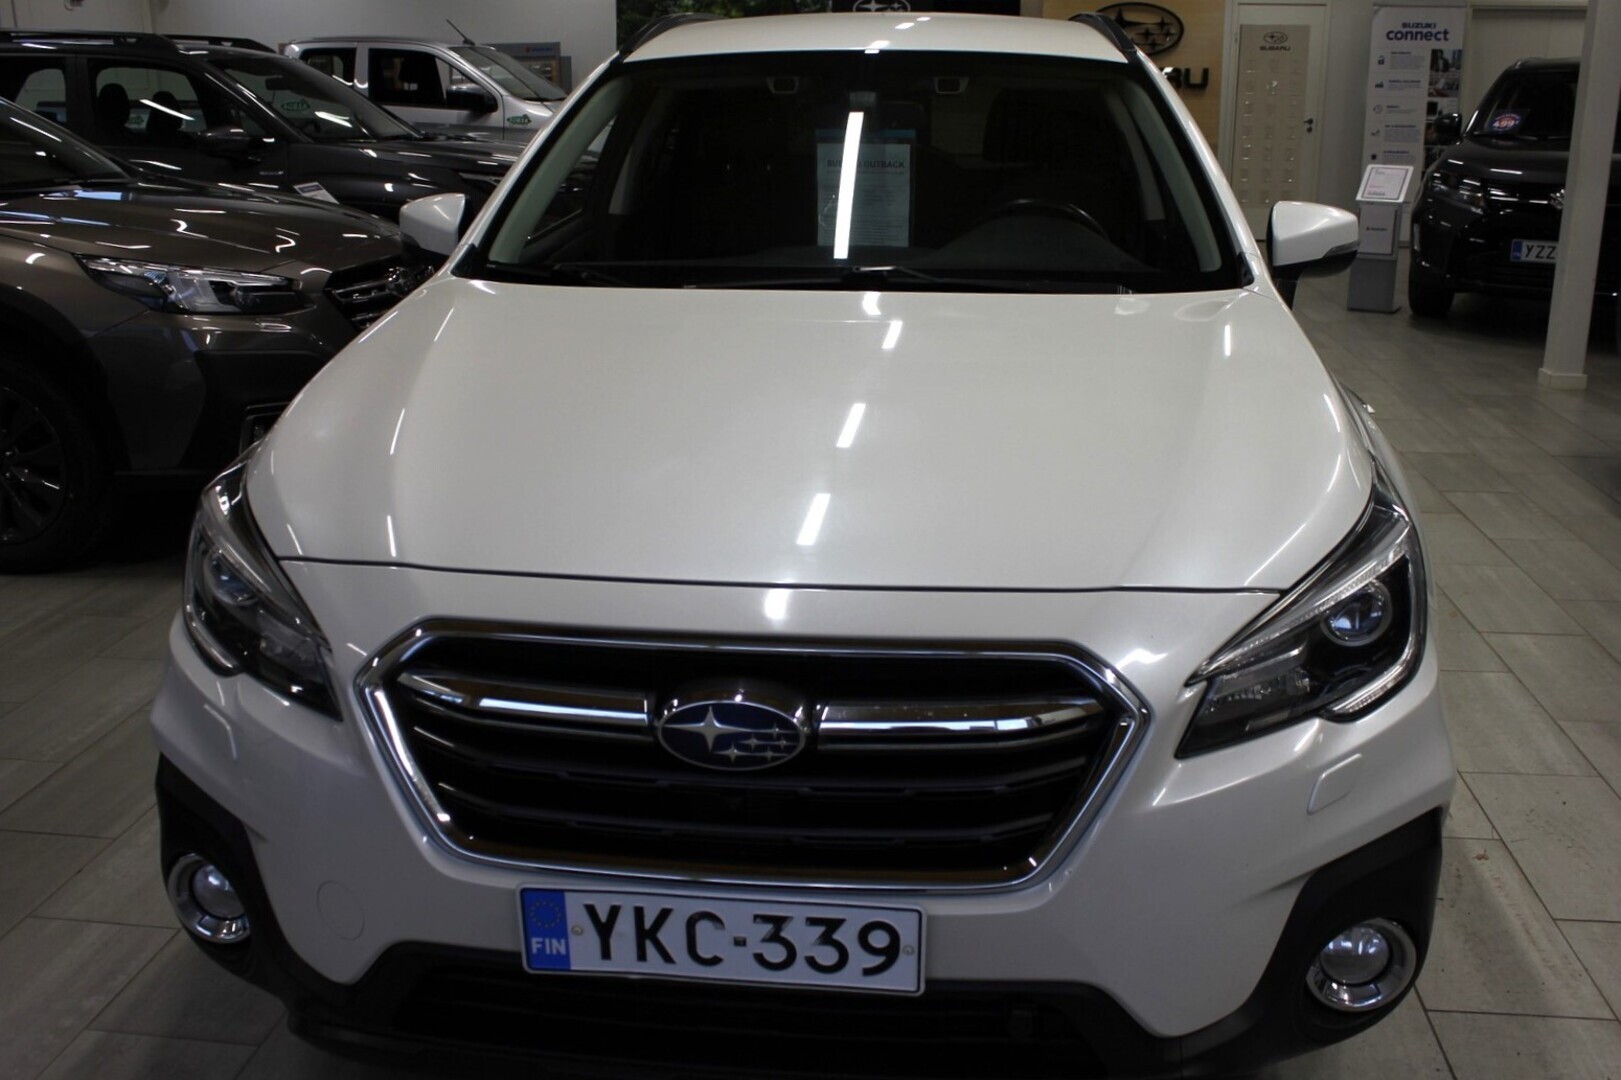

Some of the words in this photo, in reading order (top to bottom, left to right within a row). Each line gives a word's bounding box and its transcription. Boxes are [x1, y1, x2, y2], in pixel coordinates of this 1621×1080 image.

[1386, 28, 1450, 41] connect
[864, 160, 905, 169] OUTBACK
[1525, 244, 1557, 260] YZZ
[531, 937, 566, 955] FIN
[583, 903, 900, 977] YKC-339
